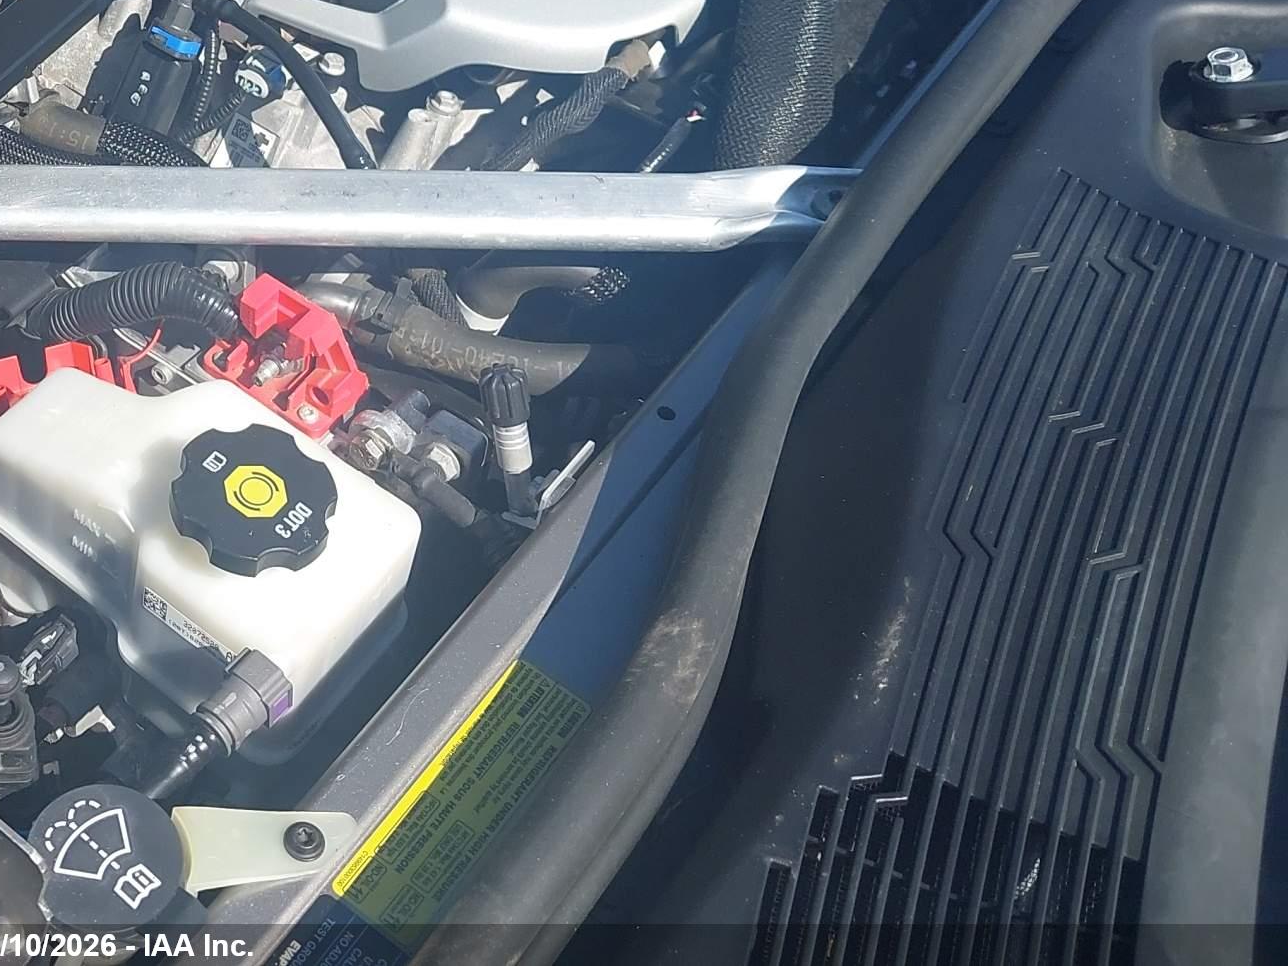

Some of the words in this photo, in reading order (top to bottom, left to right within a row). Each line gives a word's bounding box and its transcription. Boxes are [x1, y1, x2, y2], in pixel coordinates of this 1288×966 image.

[274, 523, 292, 539] 3
[283, 501, 313, 532] DOT
[470, 719, 521, 781] REFRIGERANT
[507, 742, 558, 804] REFRIGERANT
[451, 775, 476, 803] SOUS
[428, 798, 457, 832] HAUTE
[484, 799, 514, 834] UNDER
[393, 827, 434, 876] PRESSION
[466, 829, 491, 857] HIGH
[430, 853, 472, 903] PRESSURE
[316, 917, 336, 943] TEST
[338, 931, 354, 948] NO
[291, 940, 317, 966] GROU
